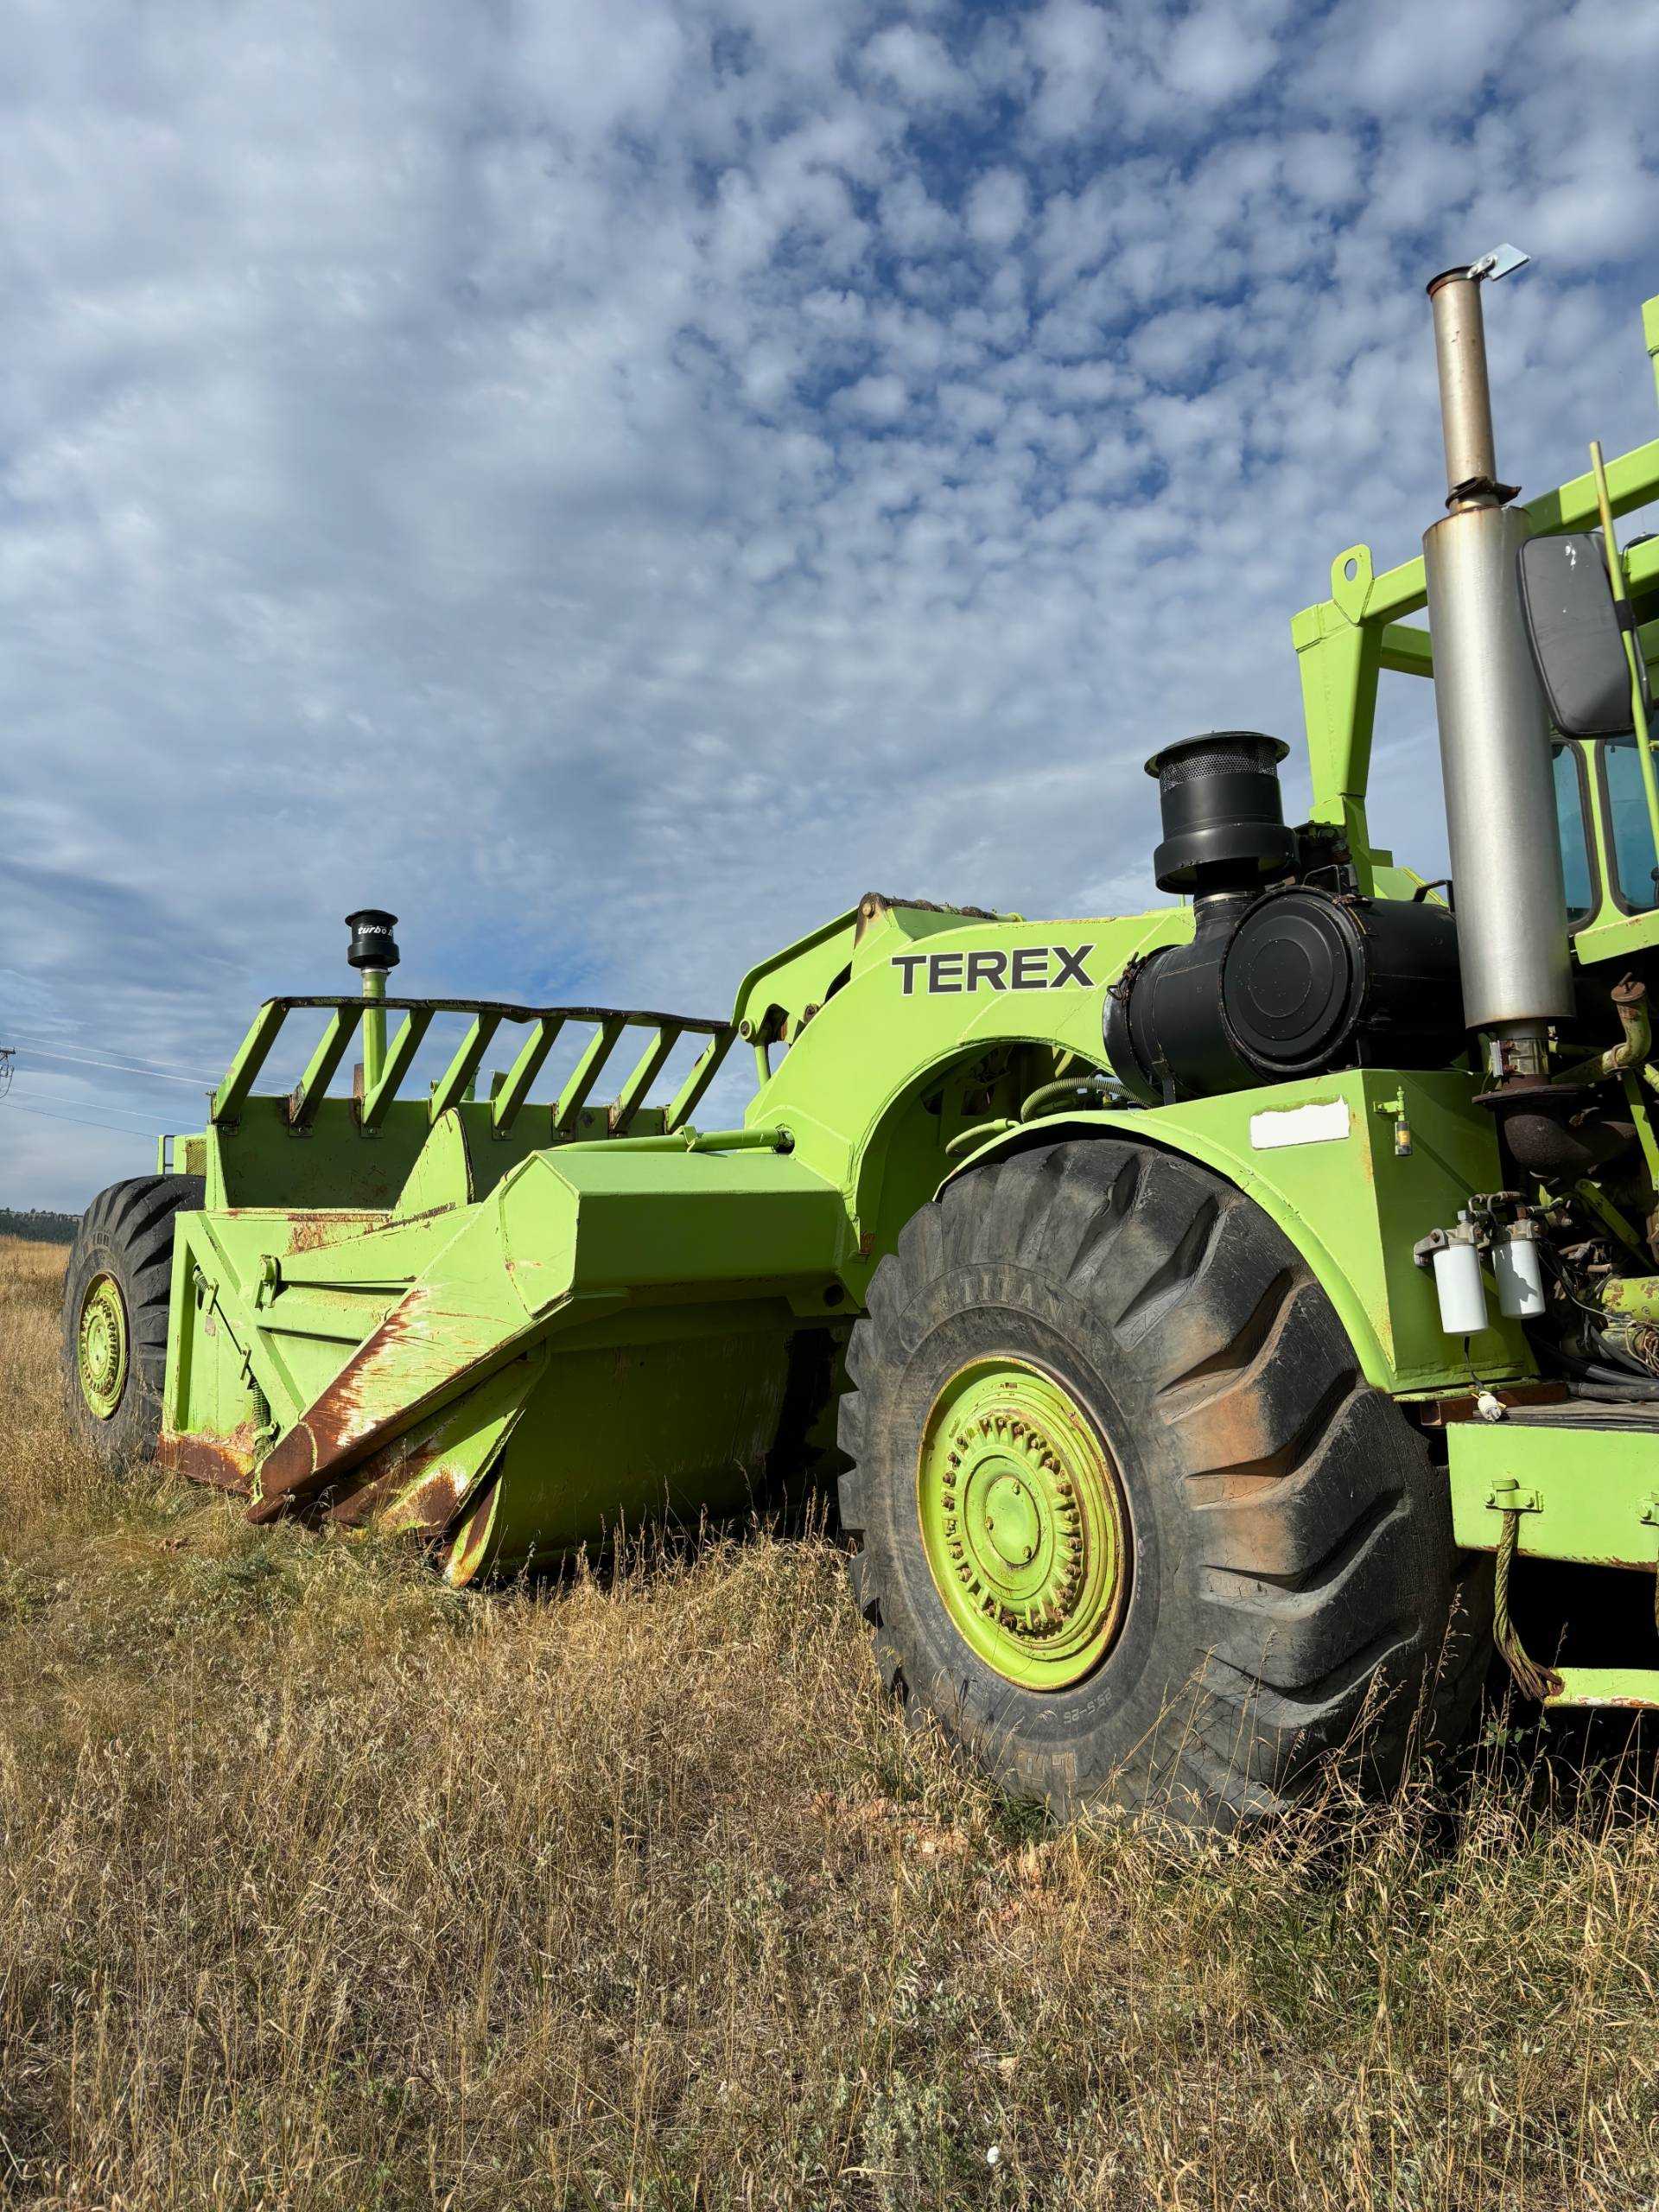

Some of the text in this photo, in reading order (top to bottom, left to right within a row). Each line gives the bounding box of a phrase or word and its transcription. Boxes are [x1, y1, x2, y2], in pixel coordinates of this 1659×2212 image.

[358, 925, 387, 935] turbo
[891, 944, 1096, 996] TEREX
[960, 1272, 1065, 1322] TITAN
